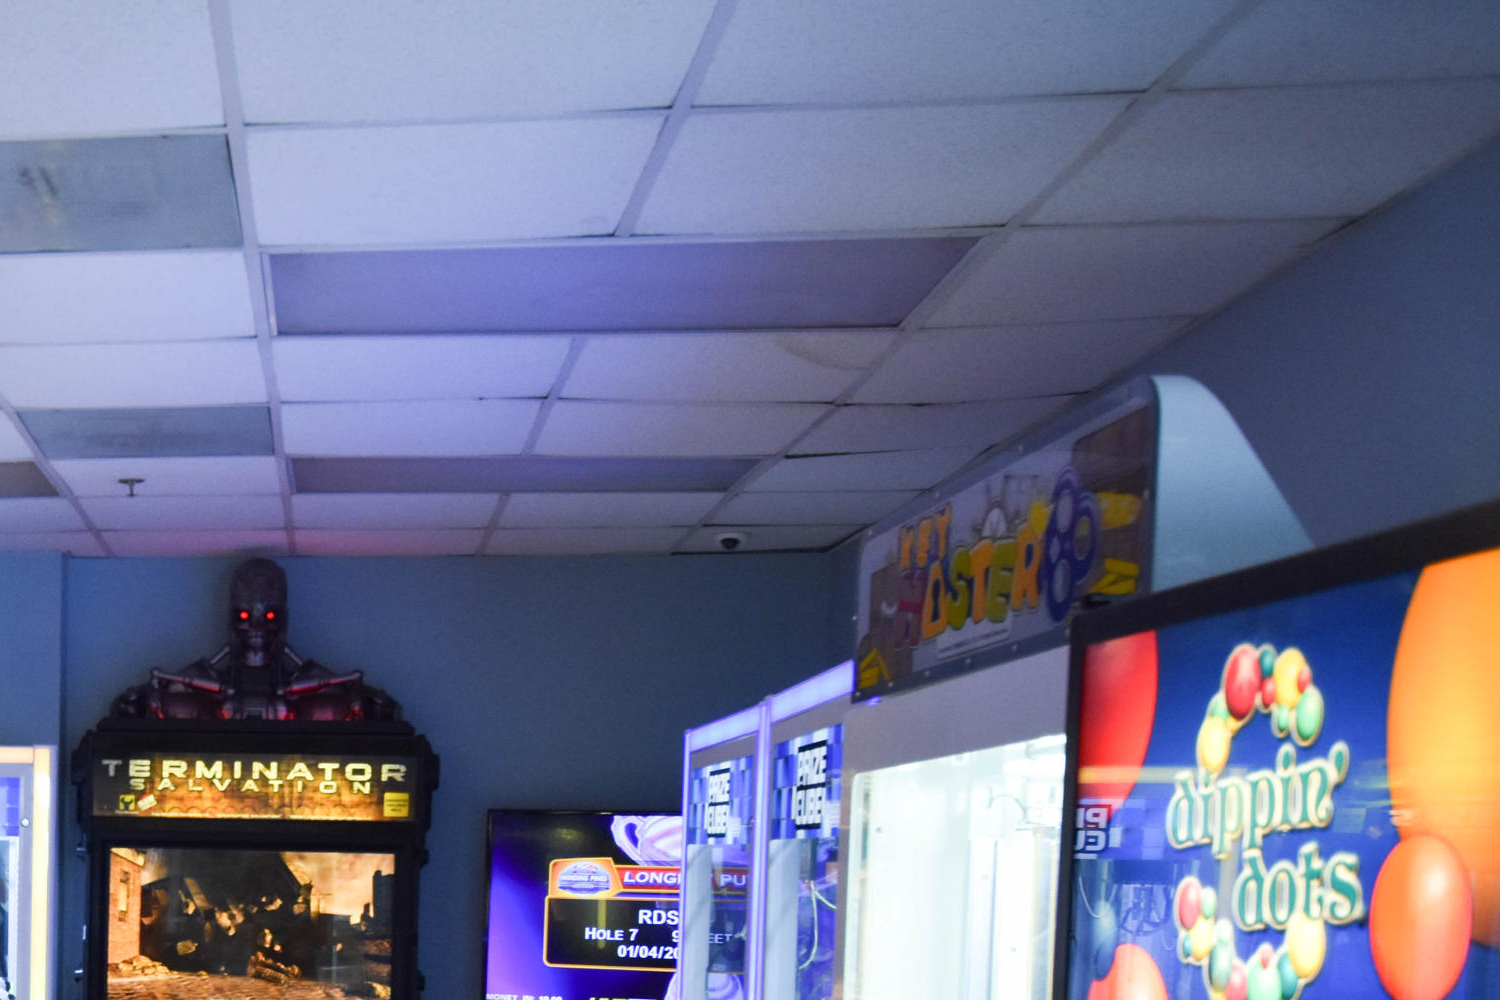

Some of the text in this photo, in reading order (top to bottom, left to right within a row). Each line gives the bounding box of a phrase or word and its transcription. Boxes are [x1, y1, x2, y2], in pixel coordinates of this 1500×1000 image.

[102, 759, 408, 783] TERMINATOR
[129, 777, 372, 795] SALVATION
[1233, 842, 1365, 931] dots
[638, 909, 679, 925] RDS
[585, 927, 624, 941] HOLE
[630, 928, 639, 941] 7
